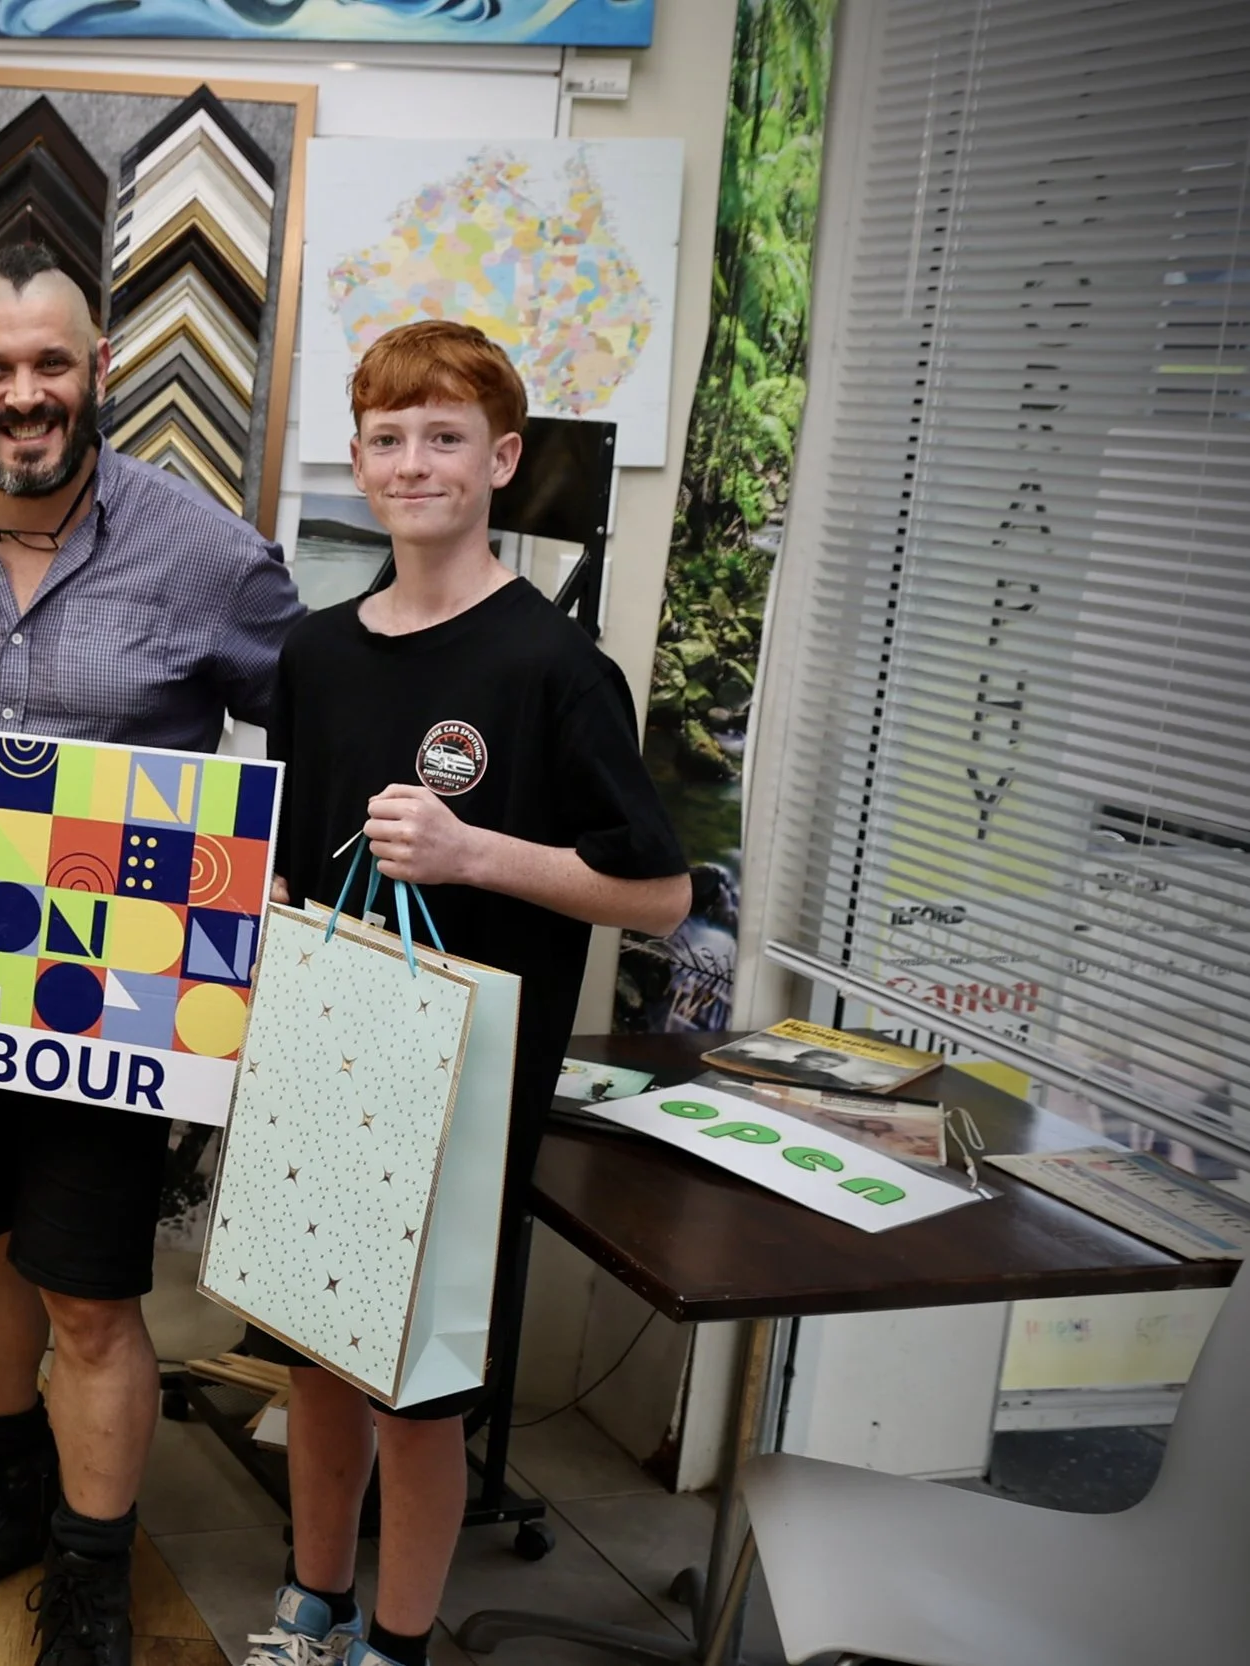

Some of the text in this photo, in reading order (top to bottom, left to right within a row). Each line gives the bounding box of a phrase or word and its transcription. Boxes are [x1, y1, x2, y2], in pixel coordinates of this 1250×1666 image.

[422, 725, 483, 760] AUSSIE CAR SPOTTING
[423, 768, 471, 783] PHOTOGRAPHY
[660, 1100, 906, 1205] open
